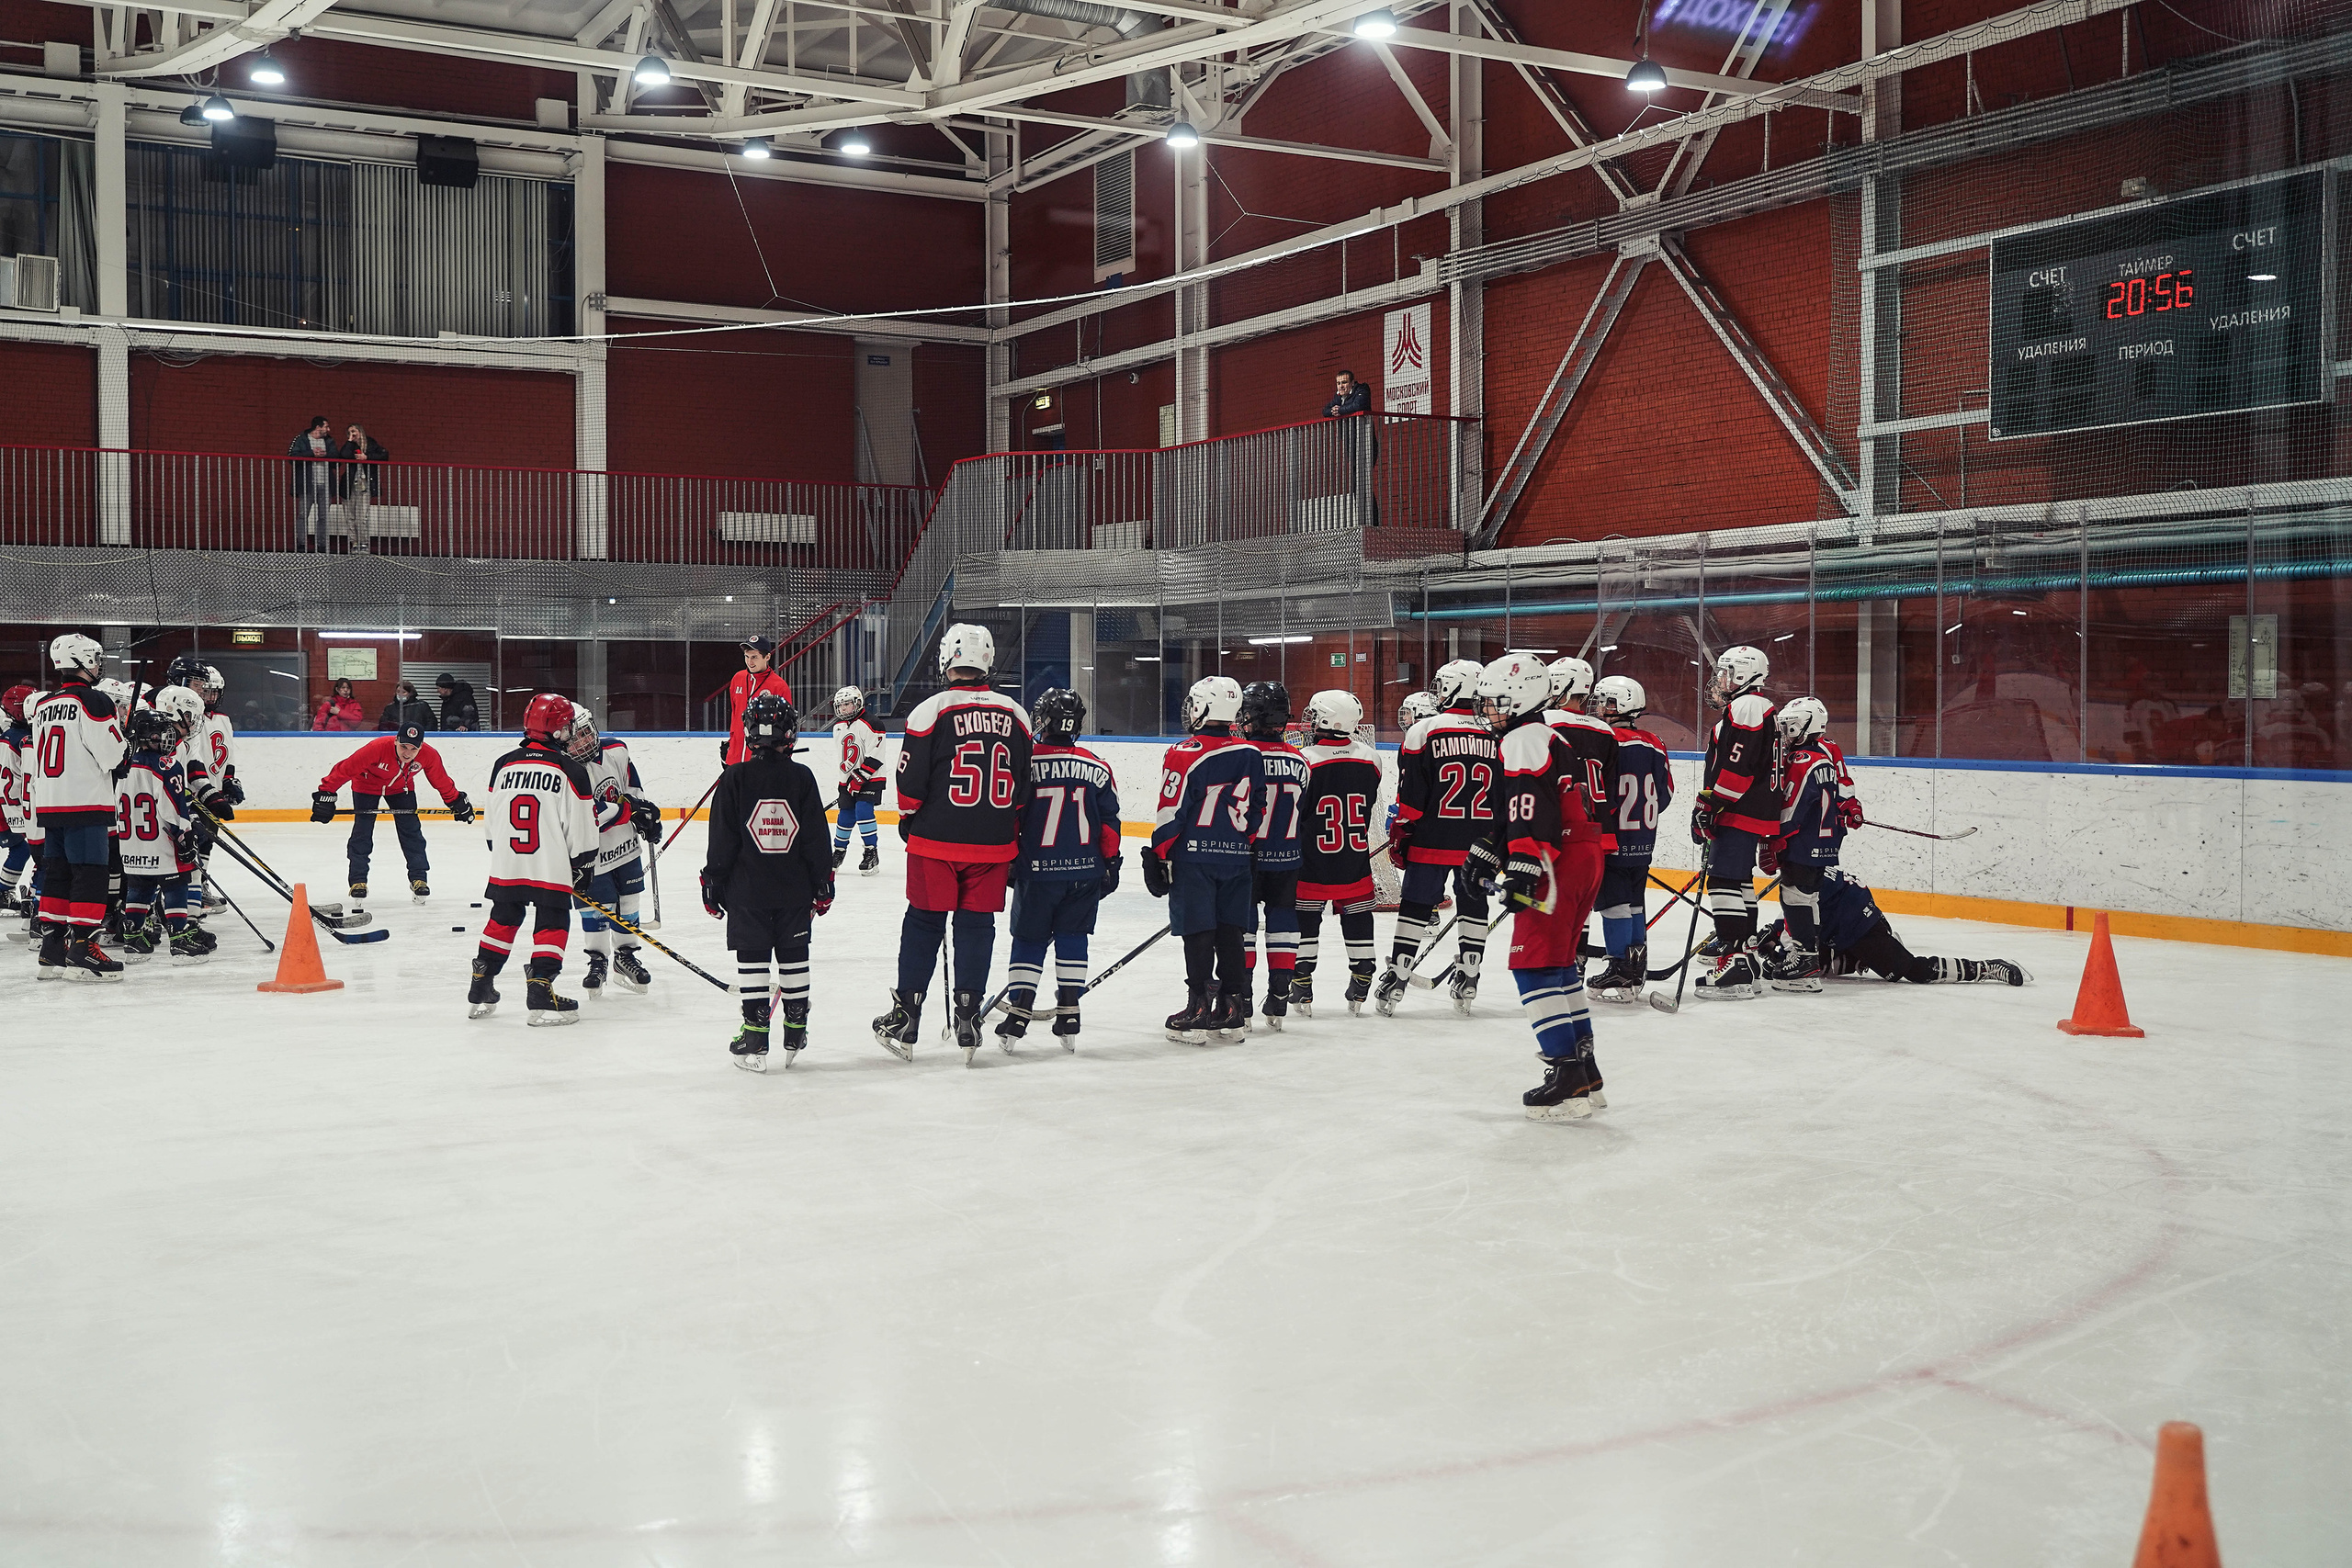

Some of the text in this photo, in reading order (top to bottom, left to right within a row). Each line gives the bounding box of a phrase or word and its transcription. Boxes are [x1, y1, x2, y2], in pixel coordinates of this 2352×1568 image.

[2233, 227, 2276, 251] СЧЕТ
[2029, 266, 2066, 288] СЧЕТ
[2119, 254, 2174, 277] ТАЙМЕР
[2107, 269, 2193, 319] 20:56
[2210, 305, 2290, 331] УДАЛЕНИЯ
[2018, 337, 2086, 360] УДАЛЕНИЯ
[2119, 340, 2174, 360] ПЕРИОД
[1385, 378, 1429, 401] МОСКОВСКИЙ
[1397, 400, 1418, 413] СПОРТ
[236, 634, 261, 643] ВЫХОД
[954, 711, 1012, 737] СКОБЕЕВ
[1060, 718, 1075, 732] 19
[876, 737, 883, 748] 7
[1729, 741, 1744, 762] 5
[0, 765, 22, 807] 2
[948, 740, 1015, 808] 56
[1438, 761, 1493, 819] 22
[1617, 773, 1658, 830] 28
[119, 792, 159, 840] 33
[1035, 785, 1091, 847] 71
[1196, 775, 1250, 832] 73
[1509, 793, 1535, 823] 88
[1819, 788, 1838, 838] 2
[510, 794, 540, 854] 9
[1317, 793, 1369, 854] 35
[1042, 857, 1094, 867] SPINETIX
